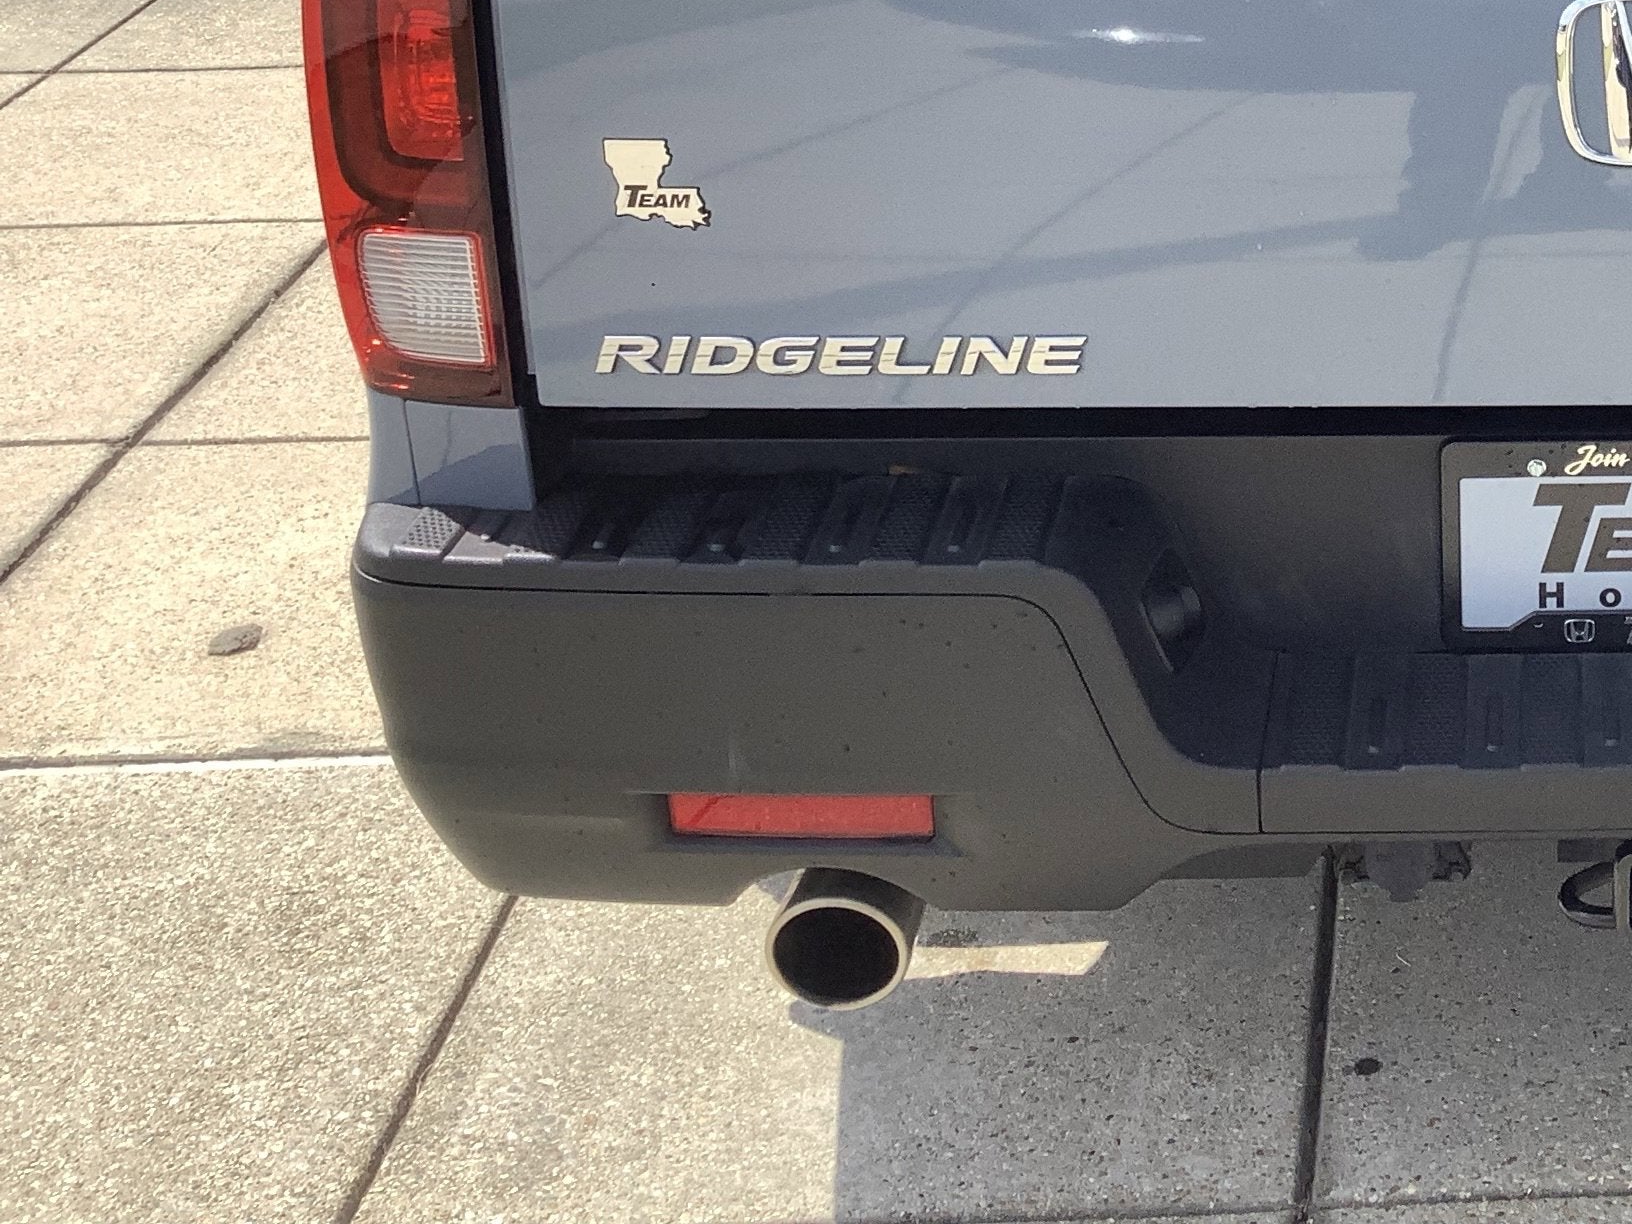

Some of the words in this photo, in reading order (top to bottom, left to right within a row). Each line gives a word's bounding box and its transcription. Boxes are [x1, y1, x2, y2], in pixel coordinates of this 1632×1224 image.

[624, 184, 691, 209] TEAM
[595, 334, 1088, 376] RIDGELINE
[1564, 444, 1630, 475] Join
